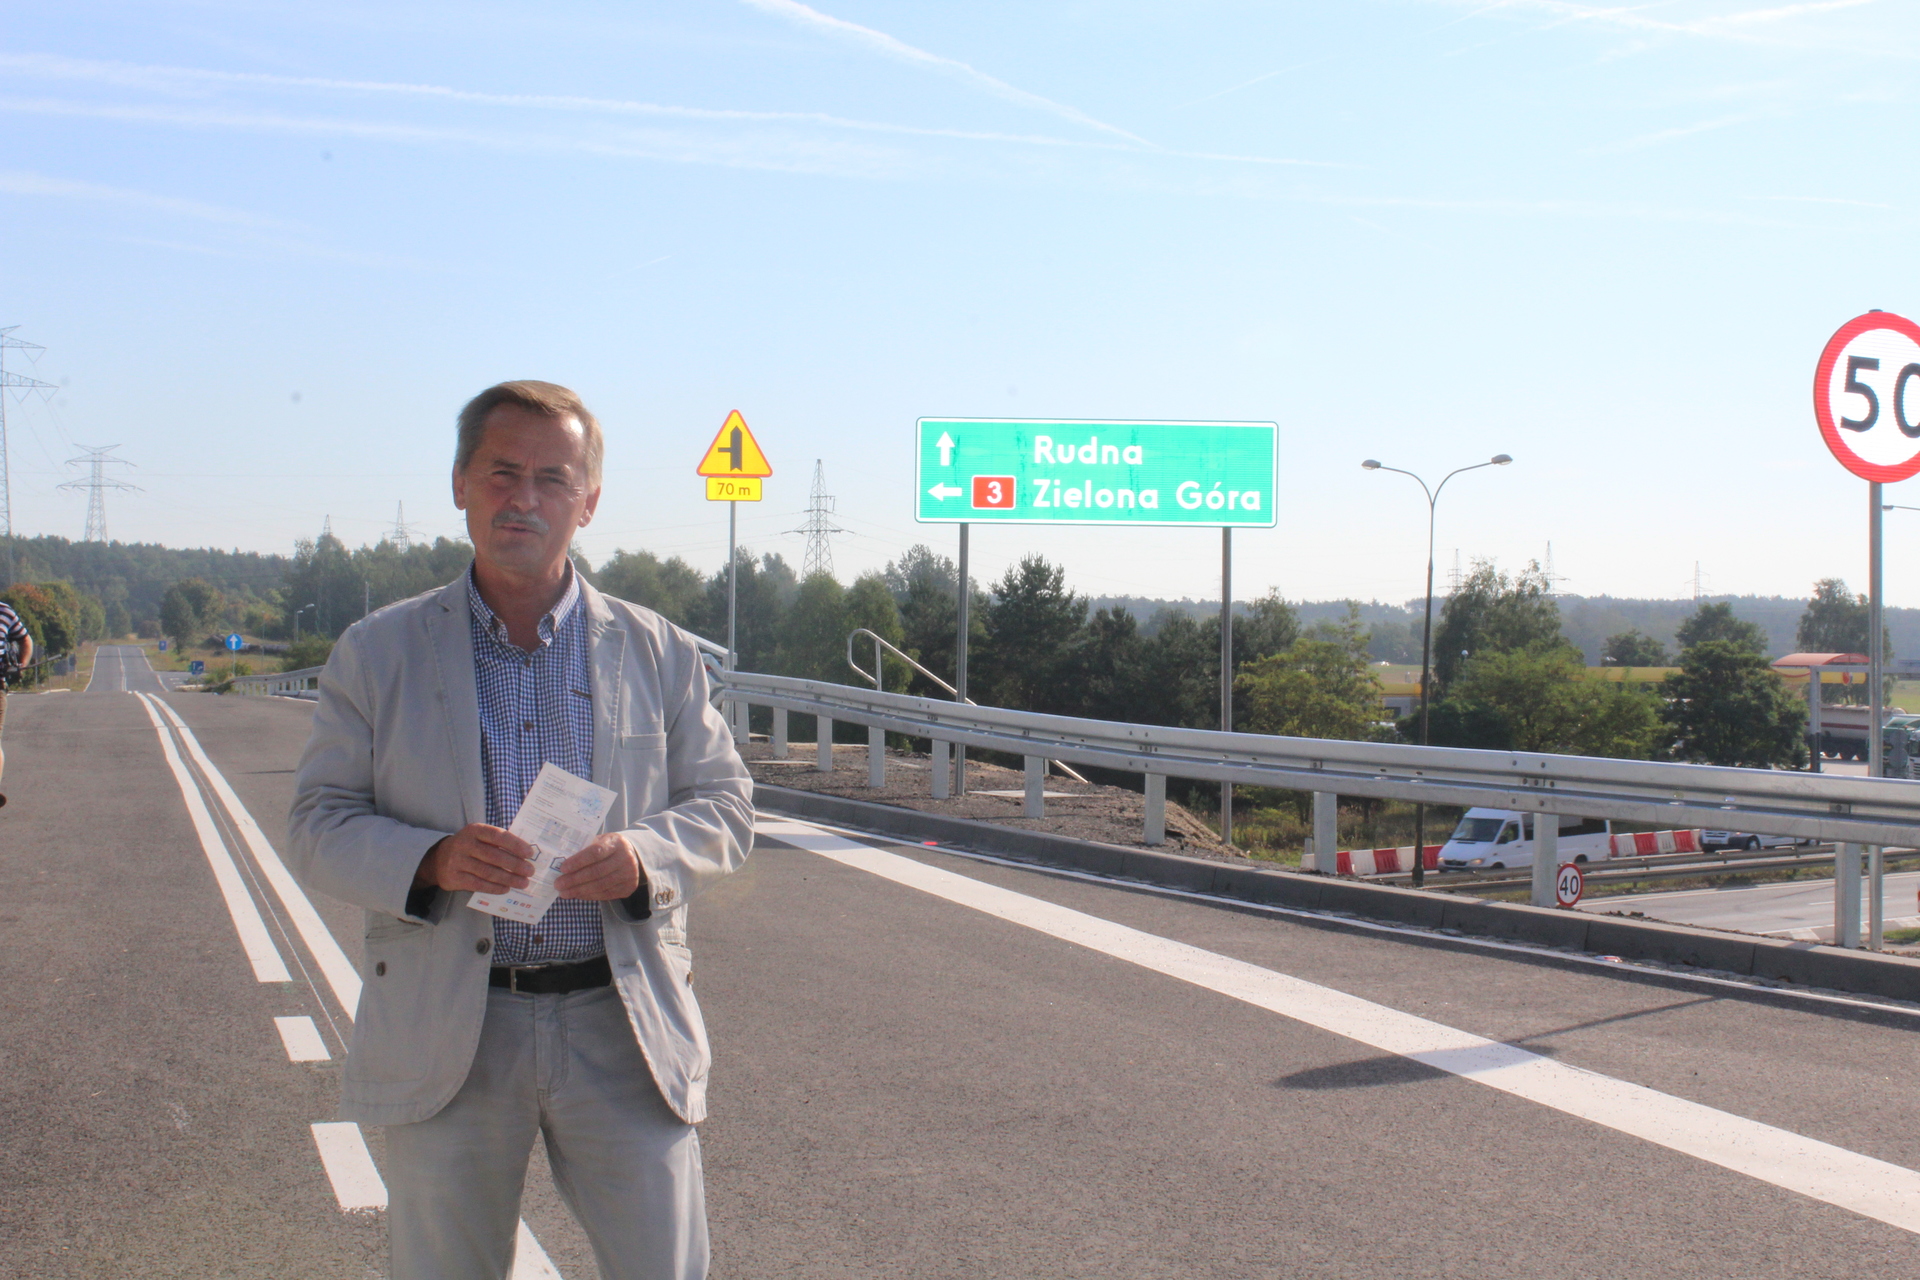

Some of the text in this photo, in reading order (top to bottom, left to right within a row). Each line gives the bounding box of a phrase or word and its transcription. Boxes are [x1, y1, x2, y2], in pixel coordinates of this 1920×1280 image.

[1840, 355, 1920, 438] 50
[1034, 435, 1143, 465] Rudna
[717, 483, 751, 495] 70 m
[986, 479, 1261, 510] 3 Zielona Góra
[1560, 875, 1579, 895] 40
